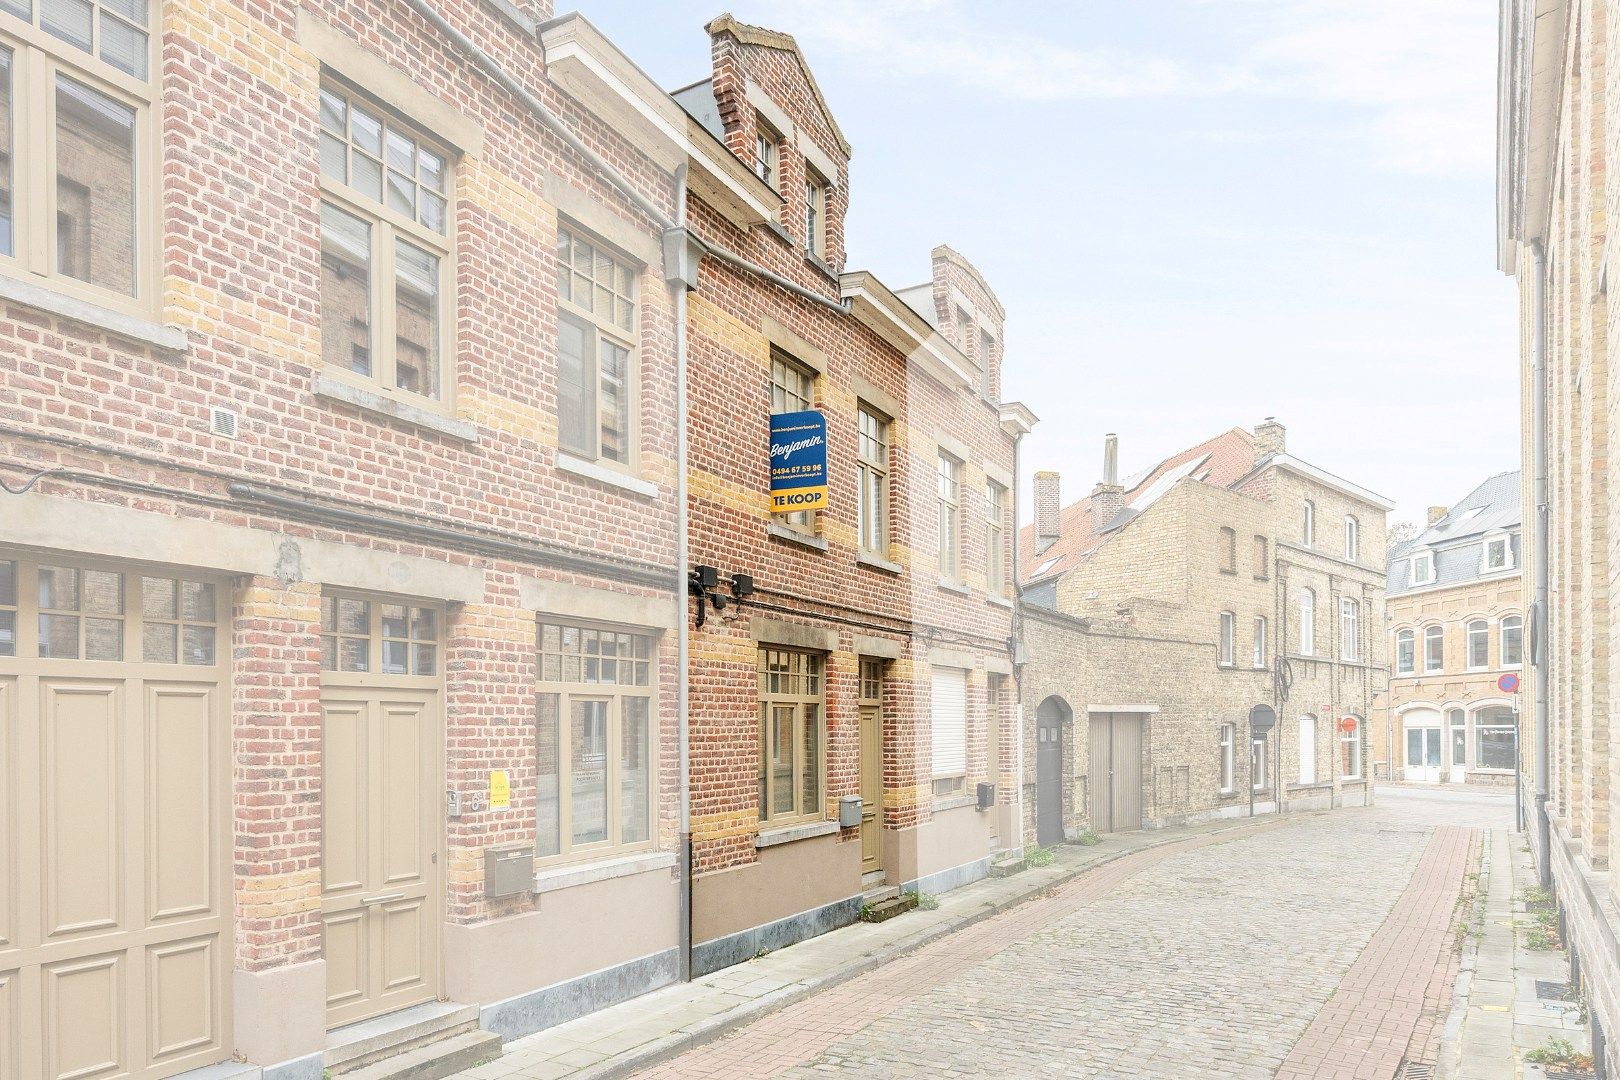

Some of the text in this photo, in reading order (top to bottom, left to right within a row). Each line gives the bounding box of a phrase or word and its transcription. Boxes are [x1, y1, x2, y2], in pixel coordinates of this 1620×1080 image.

[772, 467, 790, 475] 0494
[773, 492, 822, 506] TE KOOP
